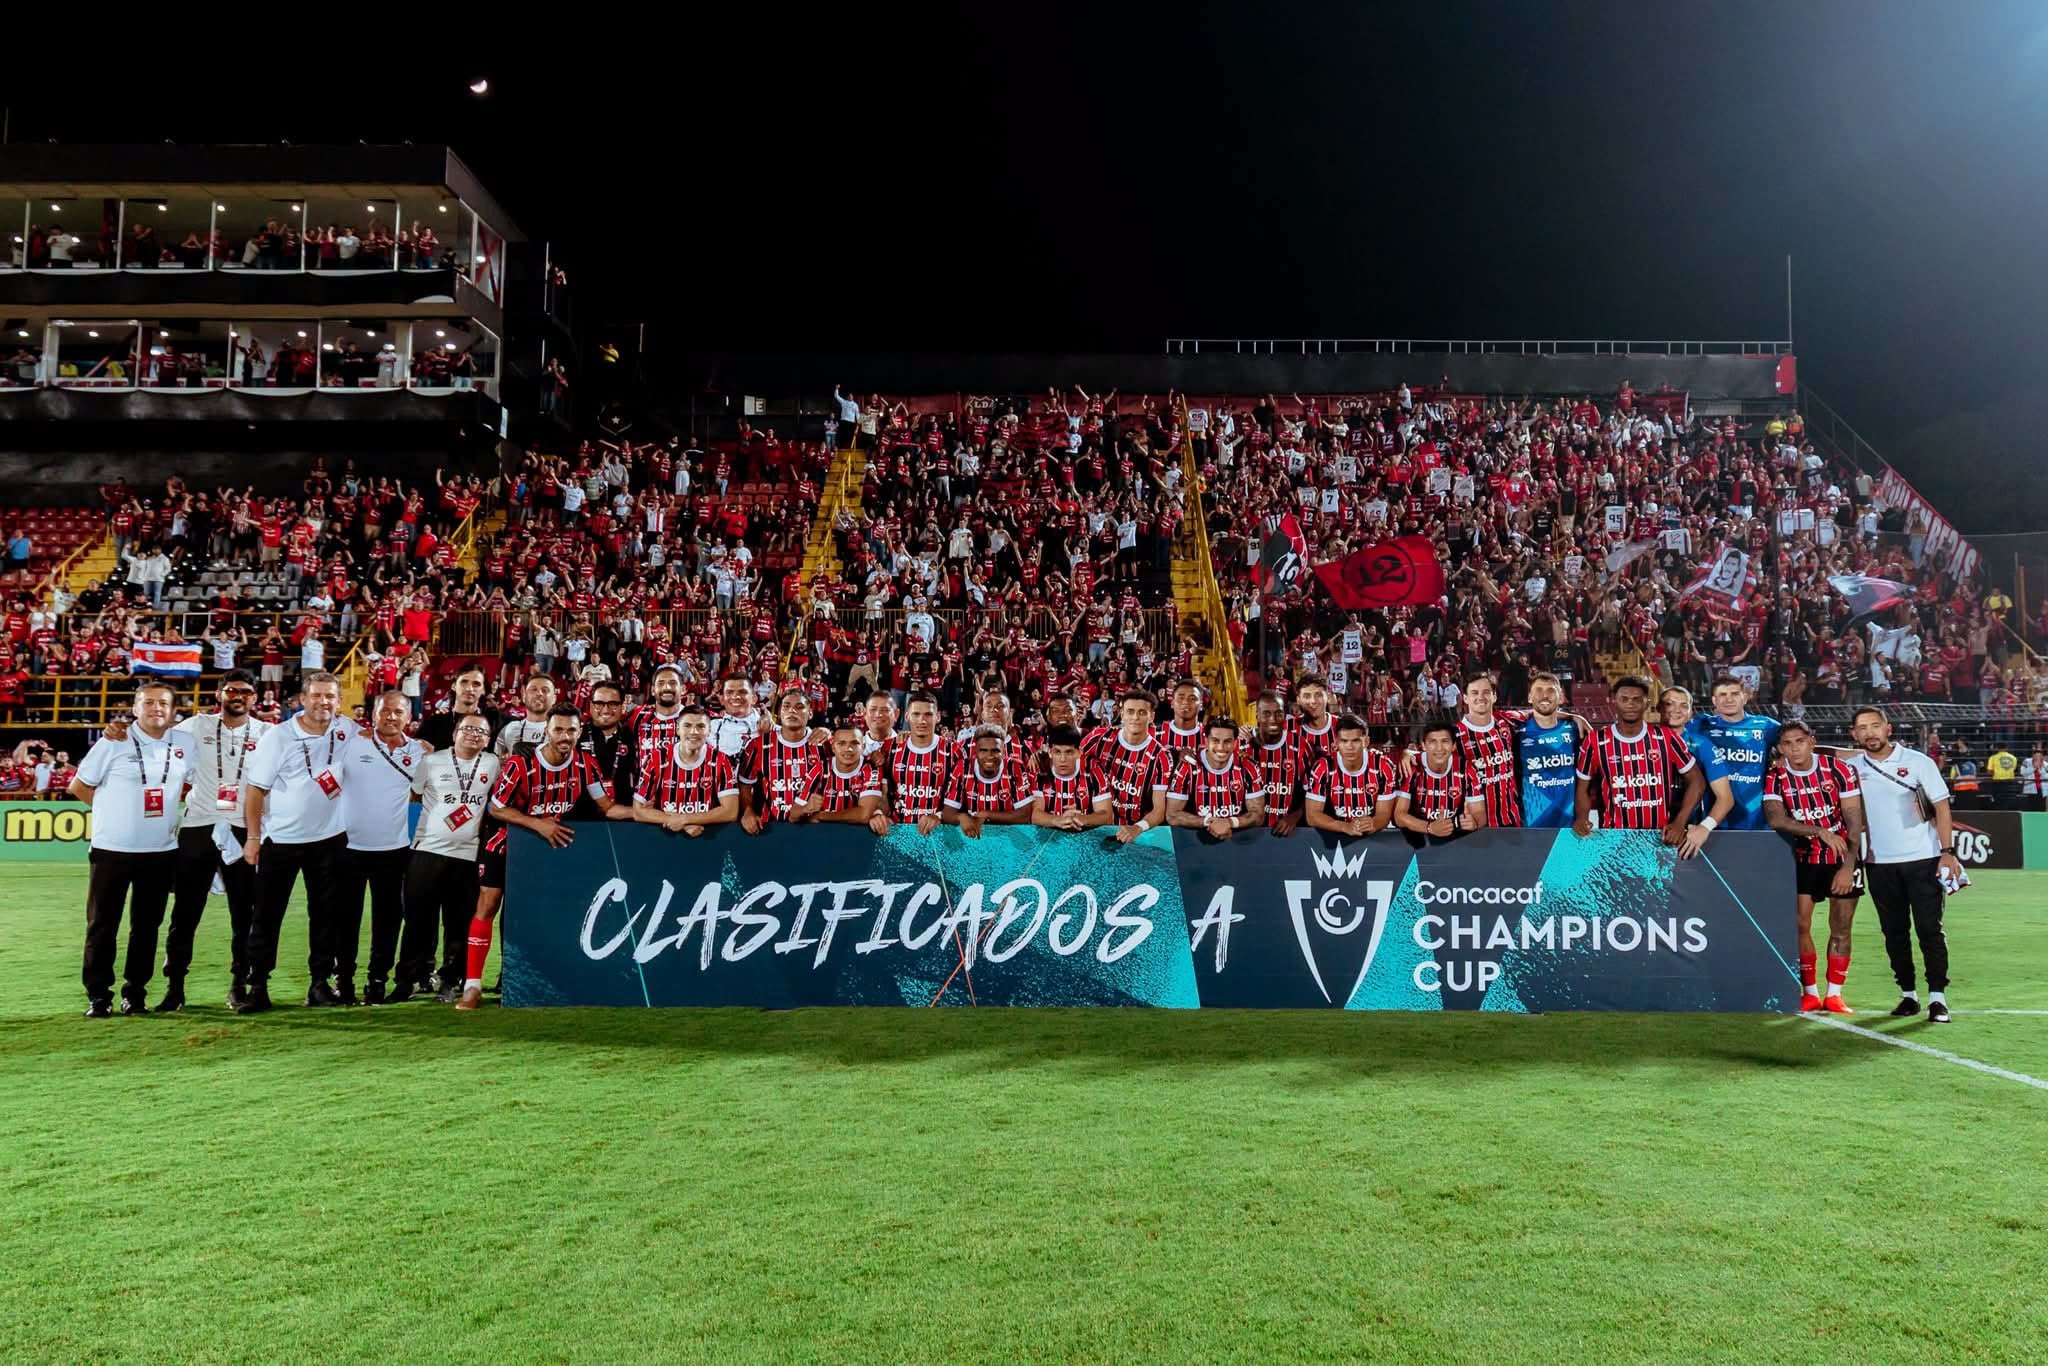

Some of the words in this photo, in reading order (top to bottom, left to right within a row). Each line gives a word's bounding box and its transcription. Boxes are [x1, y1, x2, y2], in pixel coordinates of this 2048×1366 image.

[1382, 434, 1393, 444] 12
[1340, 463, 1350, 471] 12
[1327, 495, 1334, 504] 7
[1411, 502, 1422, 511] 12
[1304, 511, 1314, 522] 12
[1344, 510, 1354, 520] 12
[1608, 514, 1623, 524] 95
[1752, 537, 1763, 546] 12
[1359, 555, 1407, 587] 12
[1346, 641, 1358, 649] 12
[1331, 673, 1343, 681] 12
[1542, 753, 1575, 768] kölbi
[1727, 748, 1763, 763] kölbi
[1627, 772, 1662, 787] kölbi
[1728, 771, 1761, 784] edismart
[908, 785, 941, 798] kölbi
[1111, 776, 1142, 797] kölbi
[460, 793, 483, 806] BAC
[1621, 797, 1663, 808] medismart
[546, 801, 574, 814] kölb
[1213, 804, 1241, 818] kölb
[1807, 804, 1836, 820] kölb
[1414, 880, 1544, 905] Concacaf
[580, 876, 1160, 971] CLASIFICADOS
[1191, 885, 1246, 974] A
[1412, 913, 1708, 953] CHAMPIONS
[1413, 960, 1501, 993] CUP
